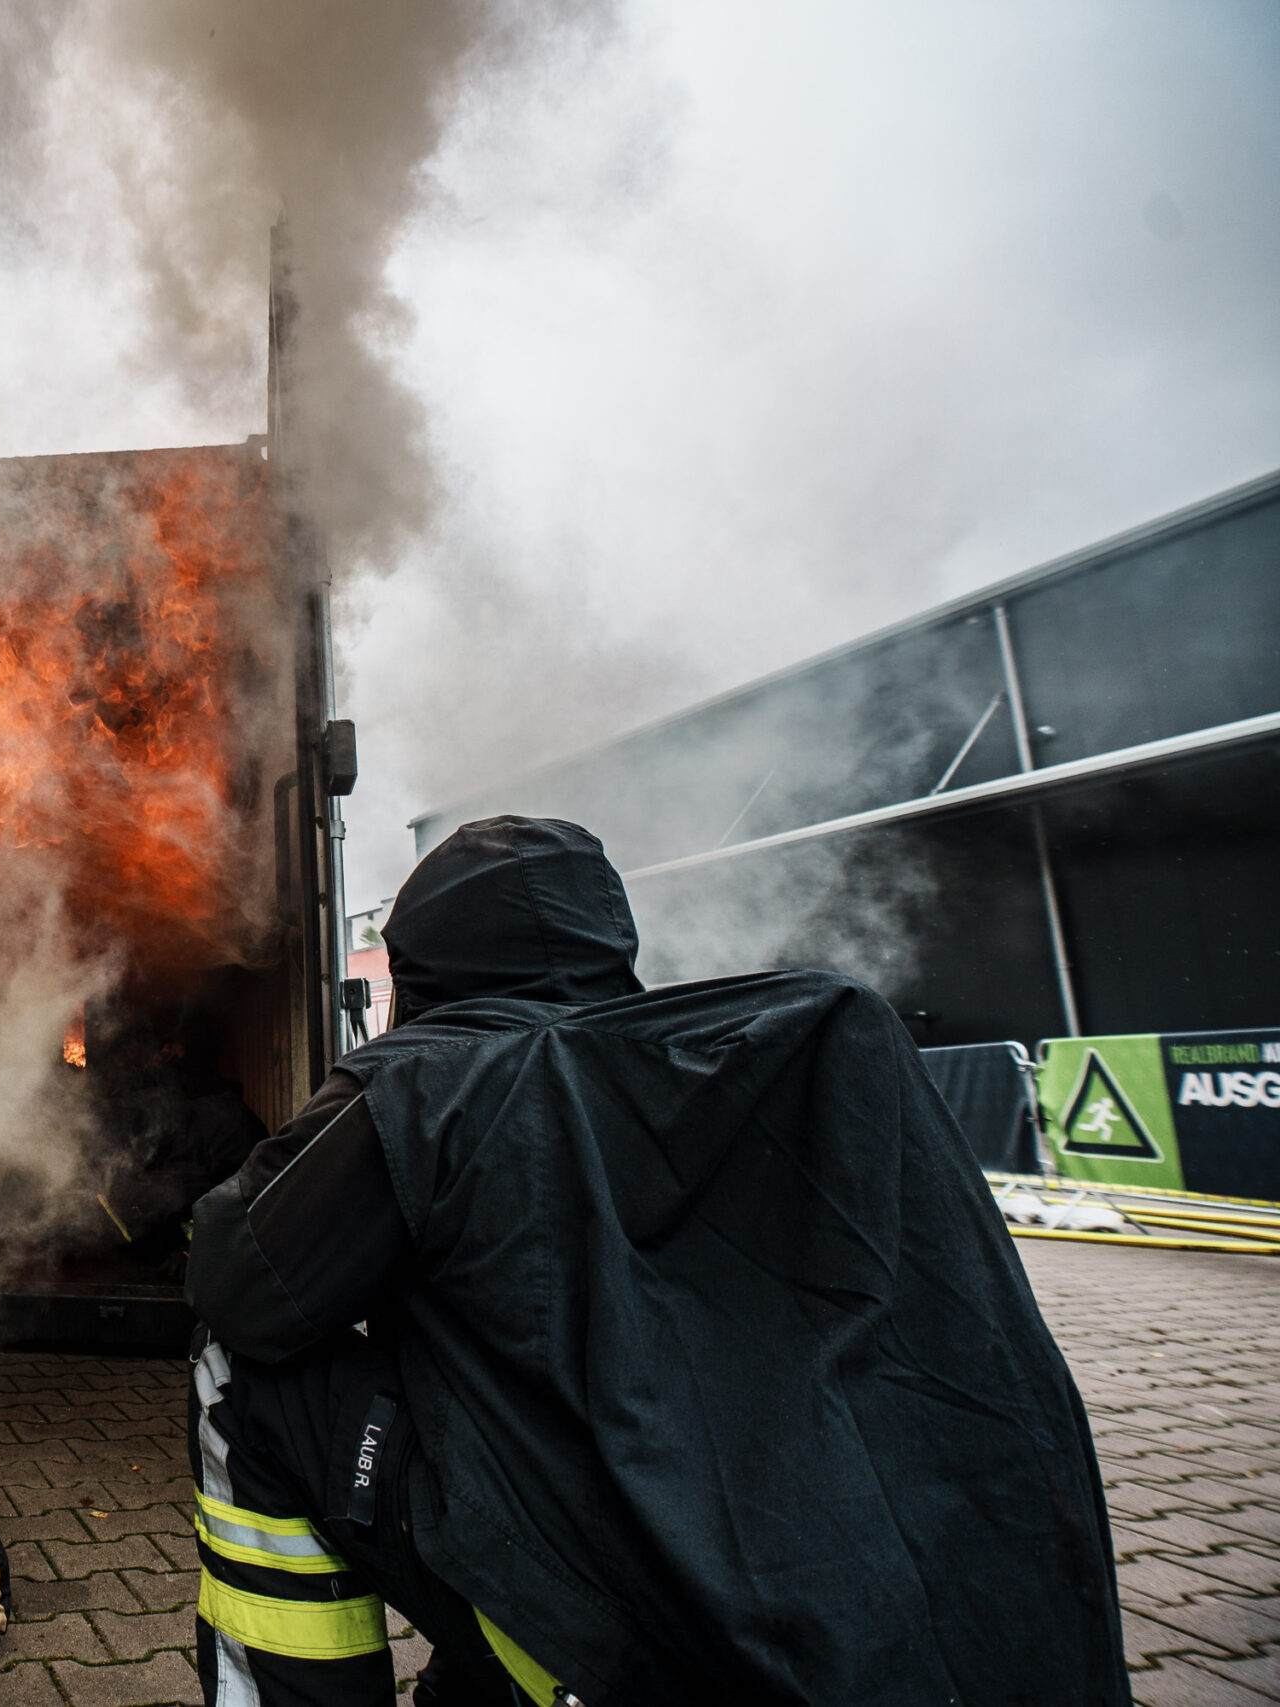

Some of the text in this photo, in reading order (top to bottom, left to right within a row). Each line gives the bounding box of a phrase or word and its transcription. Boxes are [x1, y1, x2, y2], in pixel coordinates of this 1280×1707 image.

[1178, 1071, 1280, 1108] AUSG
[354, 1424, 382, 1488] LAUB R.
